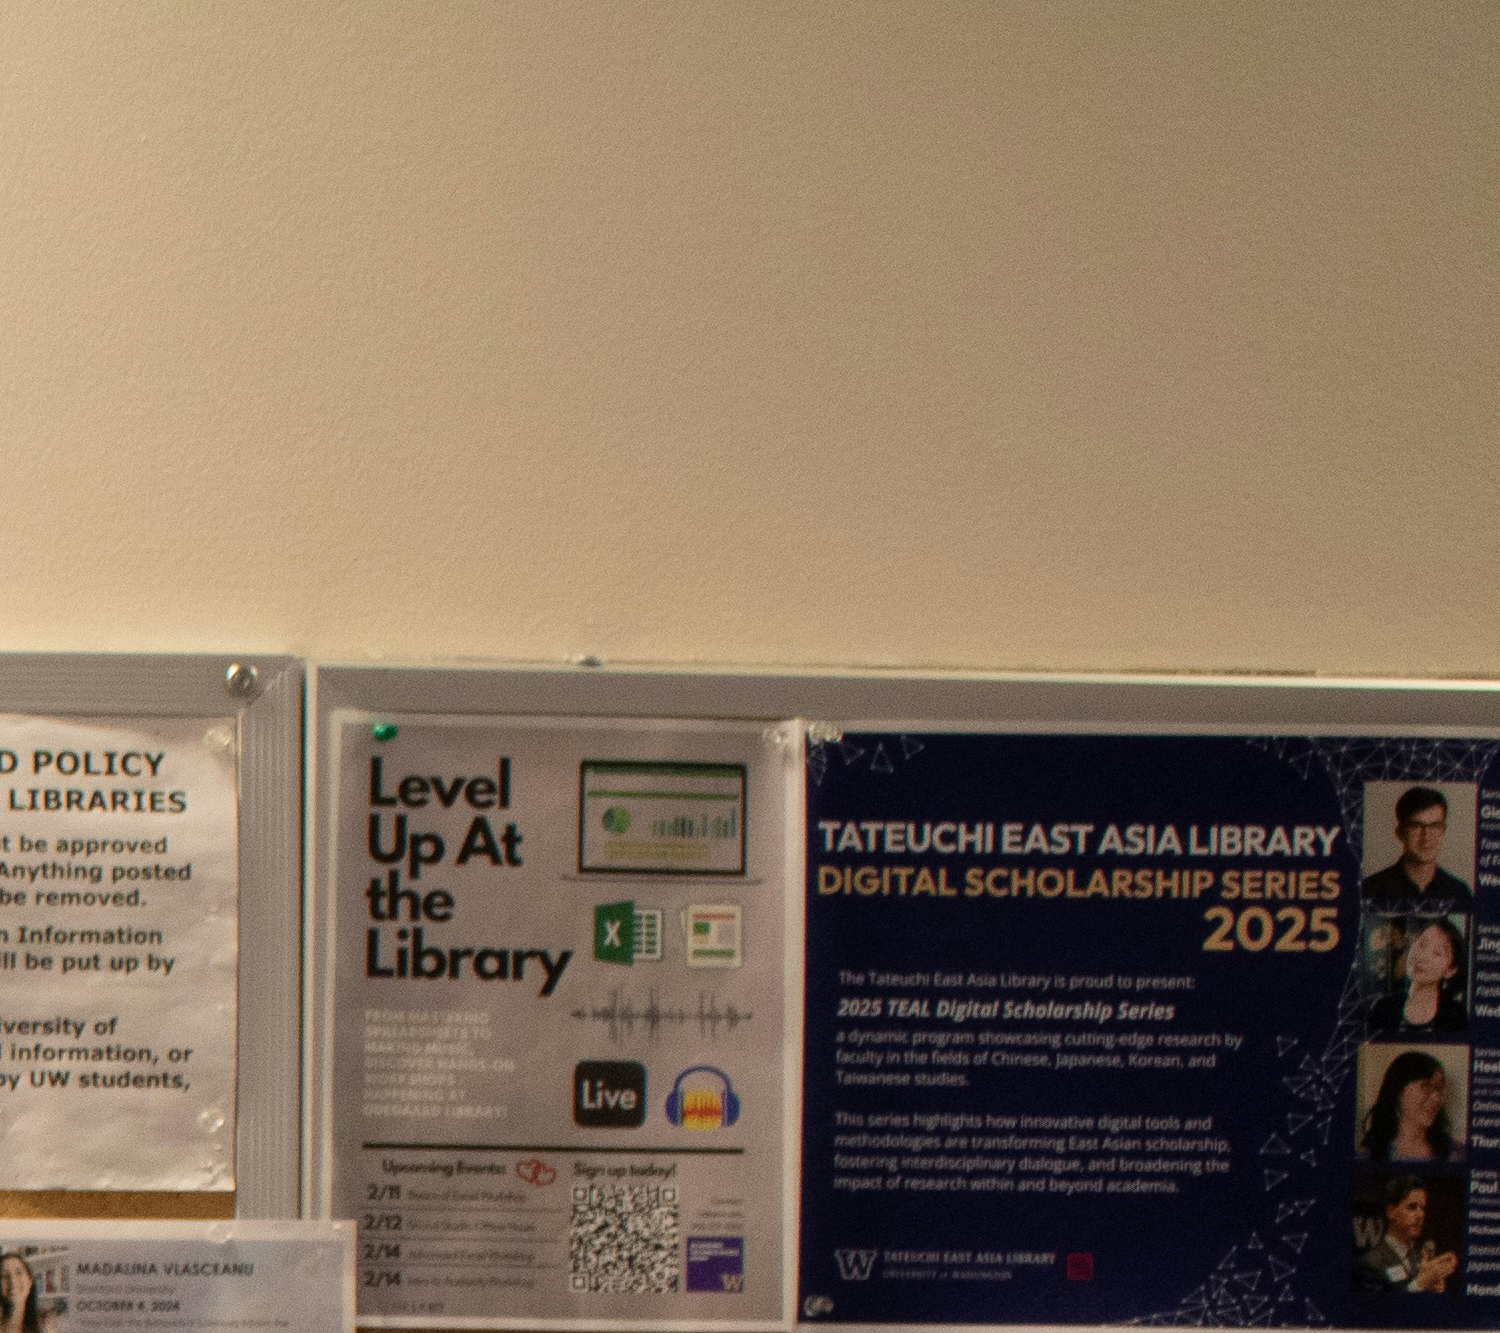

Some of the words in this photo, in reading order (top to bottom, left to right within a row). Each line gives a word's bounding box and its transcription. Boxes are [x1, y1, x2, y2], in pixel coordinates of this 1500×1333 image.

[33, 751, 165, 777] POLICY
[369, 756, 511, 810] Level
[9, 790, 188, 814] LIBRARIES
[20, 835, 48, 854] be
[57, 837, 167, 857] approved
[367, 815, 446, 878] Up
[456, 817, 523, 867] At
[818, 820, 995, 853] TATEUCHI
[1000, 823, 1094, 854] EAST
[1099, 825, 1182, 855] ASIA
[1189, 826, 1339, 857] LIBRARY
[367, 871, 454, 923] the
[1202, 907, 1340, 952] 2025
[366, 928, 574, 998] Library
[581, 1080, 637, 1111] Live
